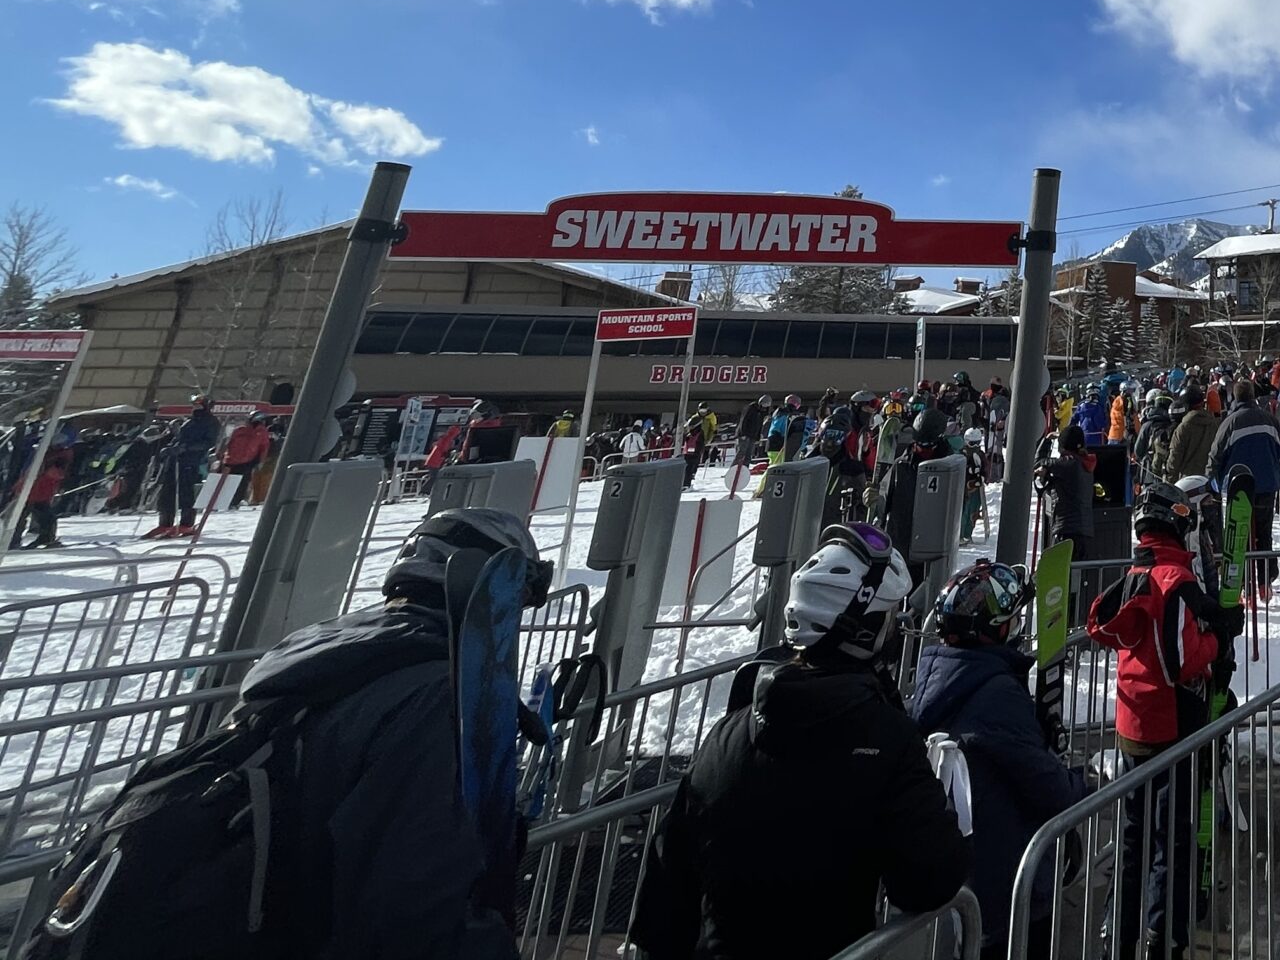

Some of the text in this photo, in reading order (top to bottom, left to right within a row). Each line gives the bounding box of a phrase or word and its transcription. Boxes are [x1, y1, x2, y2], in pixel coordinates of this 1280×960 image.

[551, 209, 878, 252] SWEETWATER
[601, 313, 693, 324] MOUNTAIN SPORTS
[628, 324, 664, 334] SCHOOL
[650, 365, 767, 383] BRIDGER
[211, 404, 256, 414] RIDGER
[610, 482, 622, 498] 2
[774, 481, 784, 497] 3
[928, 477, 938, 492] 4
